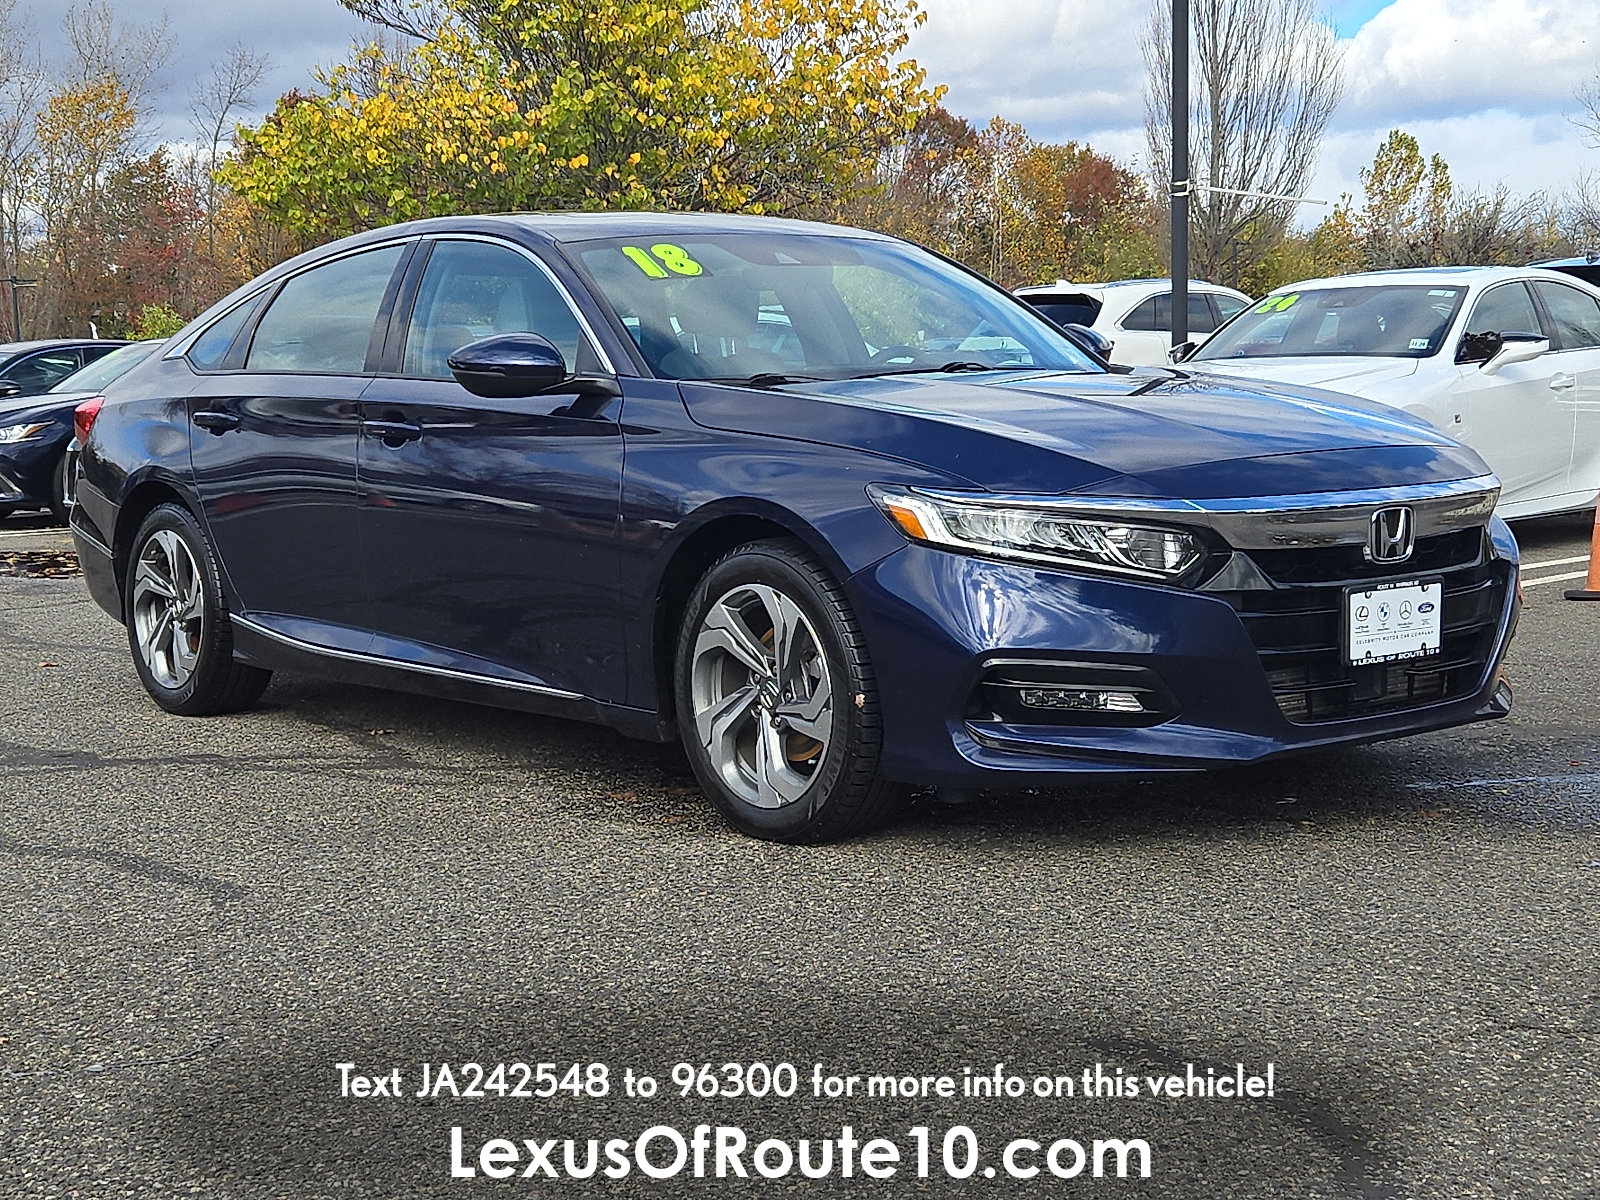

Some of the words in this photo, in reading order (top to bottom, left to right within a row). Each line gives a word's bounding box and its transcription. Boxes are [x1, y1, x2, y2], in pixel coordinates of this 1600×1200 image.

[621, 243, 703, 278] 18
[1358, 656, 1385, 665] LEXUS
[1398, 650, 1425, 660] ROUTE
